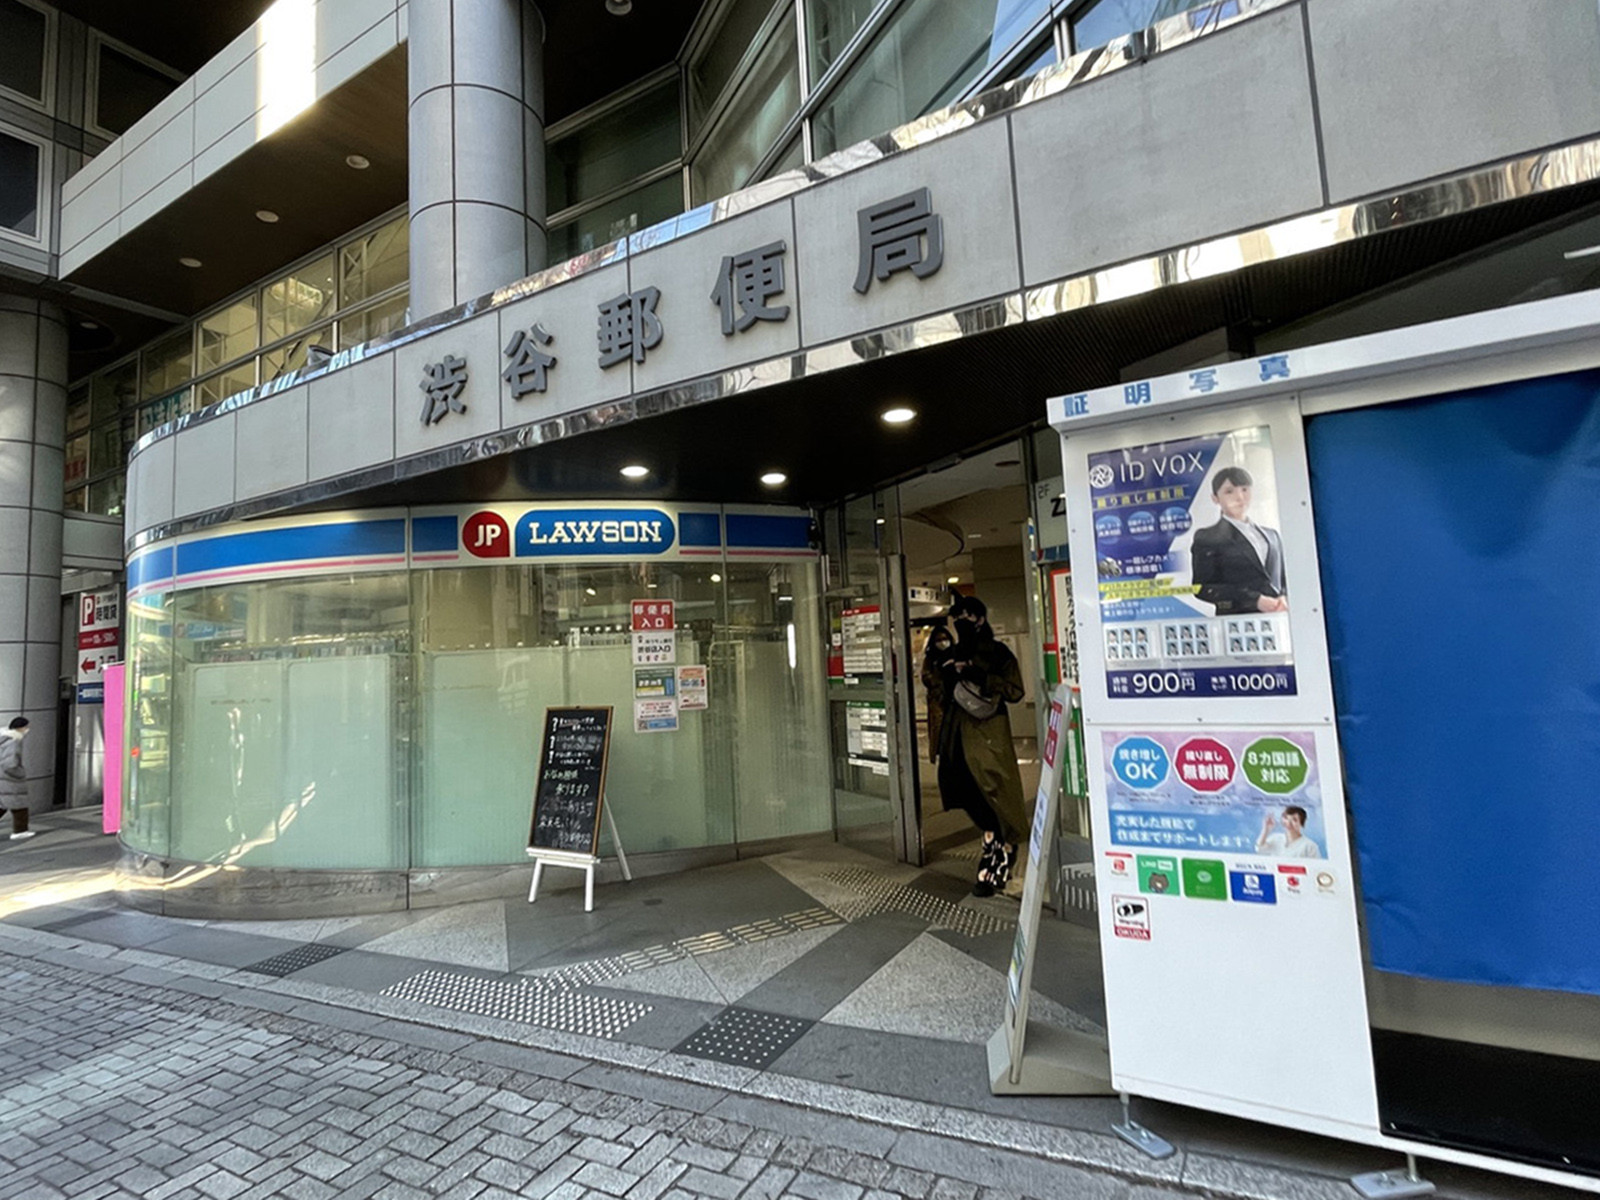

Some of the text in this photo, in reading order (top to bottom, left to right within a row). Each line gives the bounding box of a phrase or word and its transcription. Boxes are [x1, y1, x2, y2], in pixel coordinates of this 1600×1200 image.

[419, 187, 945, 426] 渋谷郵便局
[1063, 354, 1291, 418] 証明写真
[1119, 450, 1205, 484] ID VOX
[474, 520, 662, 547] JP LAWSON
[83, 597, 93, 625] P
[641, 617, 665, 628] 入口
[1125, 763, 1158, 781] OK
[1182, 763, 1230, 781] 無制限
[1260, 768, 1291, 784] 対応
[1117, 927, 1150, 940] OKUDA
